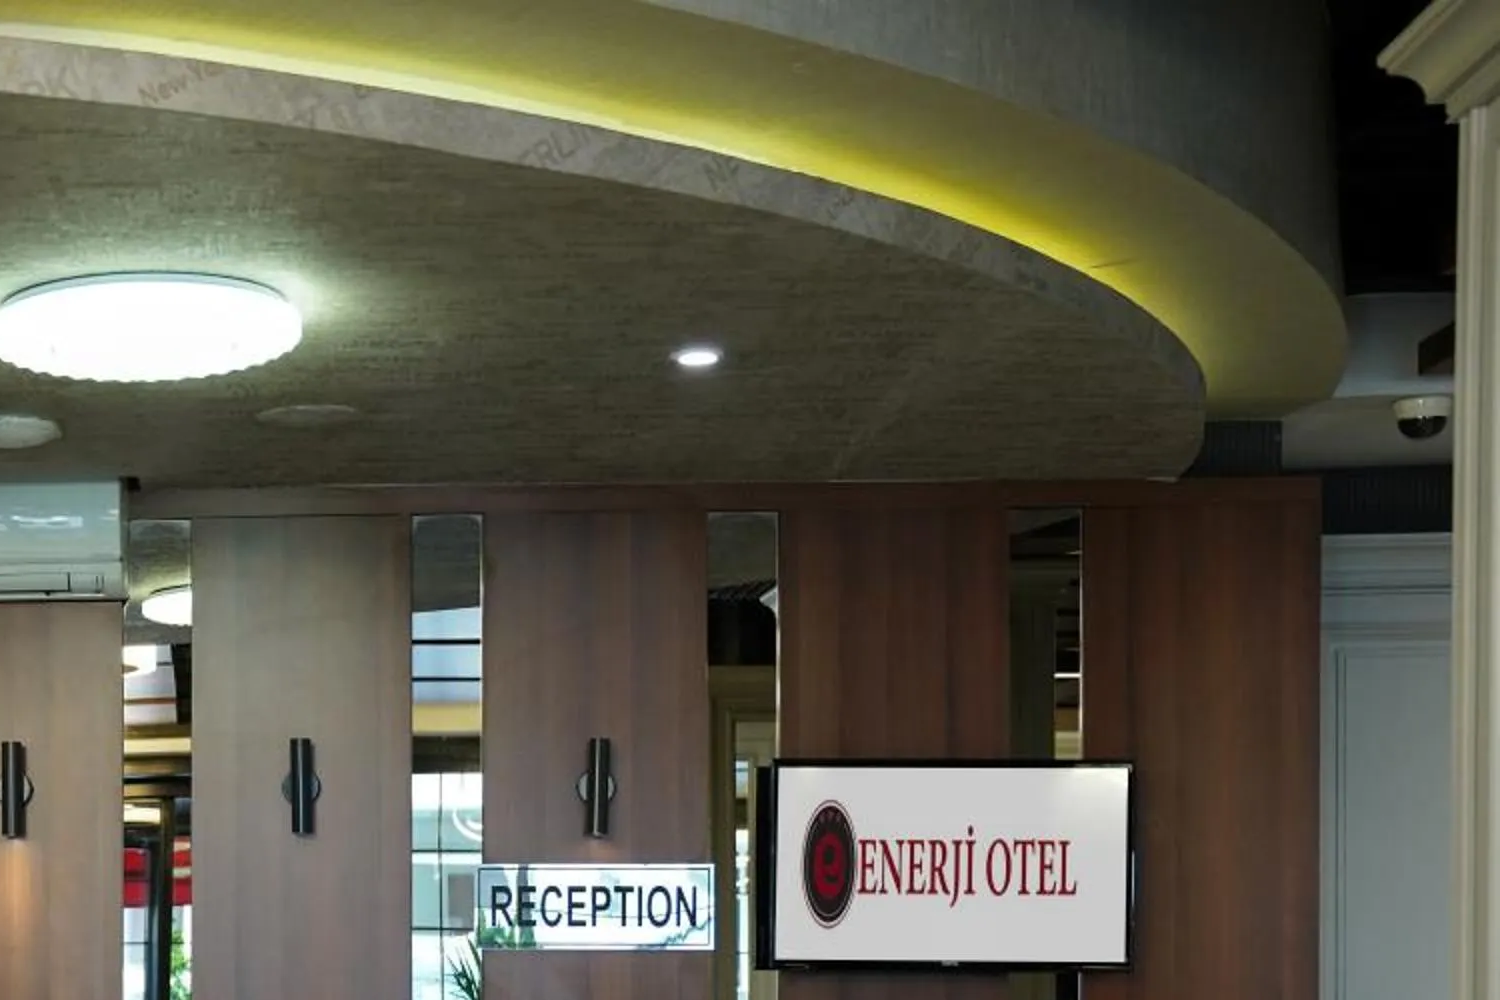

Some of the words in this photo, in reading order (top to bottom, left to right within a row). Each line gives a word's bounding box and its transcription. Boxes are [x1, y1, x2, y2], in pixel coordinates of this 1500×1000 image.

[856, 825, 976, 907] ENERJİ
[984, 838, 1078, 896] OTEL
[491, 885, 698, 928] RECEPTION
